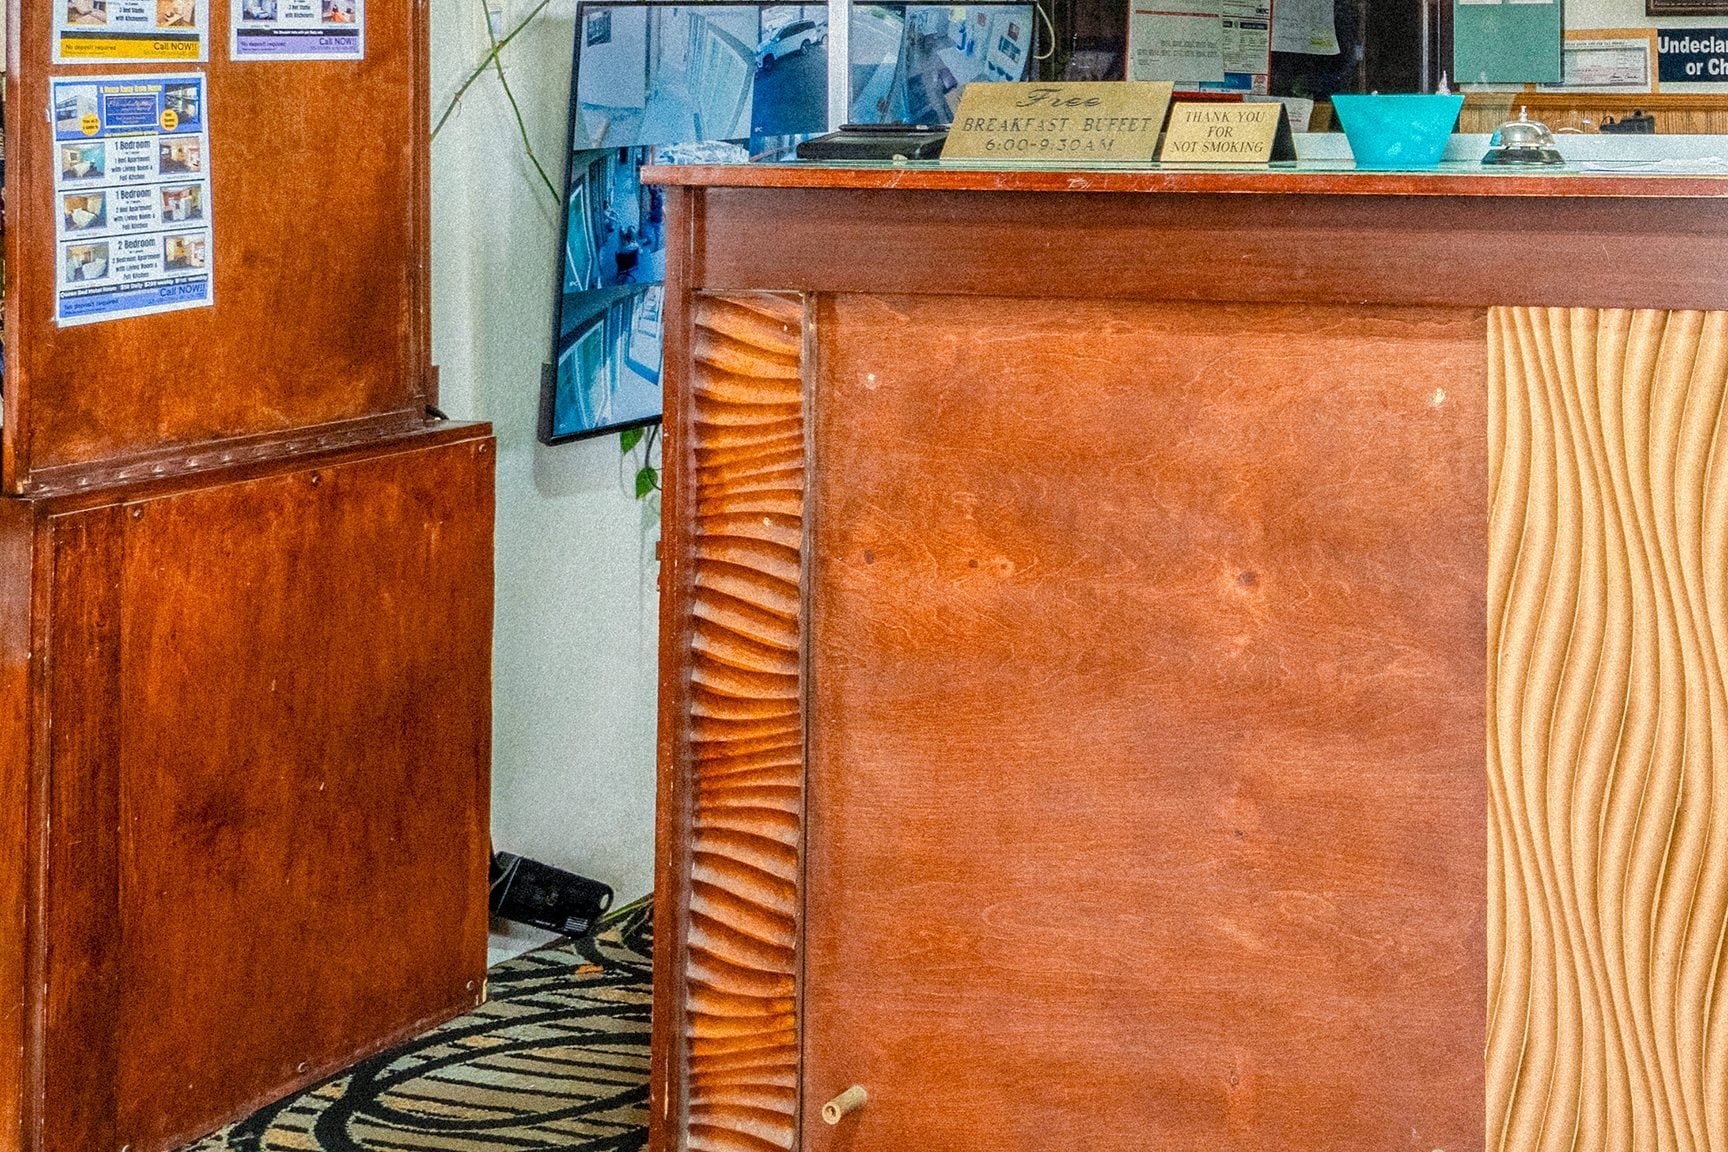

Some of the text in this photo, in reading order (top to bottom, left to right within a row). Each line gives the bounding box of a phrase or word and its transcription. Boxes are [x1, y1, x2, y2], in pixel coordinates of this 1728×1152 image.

[154, 42, 169, 50] Call
[1685, 61, 1703, 75] or
[1015, 87, 1101, 108] Free
[1185, 111, 1266, 123] THANK YOU
[962, 117, 1152, 132] BREAKFAST BUFFET
[1207, 125, 1233, 138] FOR
[120, 140, 150, 150] Bedroom
[1170, 140, 1265, 154] NOT SMOKING
[121, 189, 152, 199] Bedroom
[124, 239, 156, 249] Bedroom
[160, 288, 177, 297] Call
